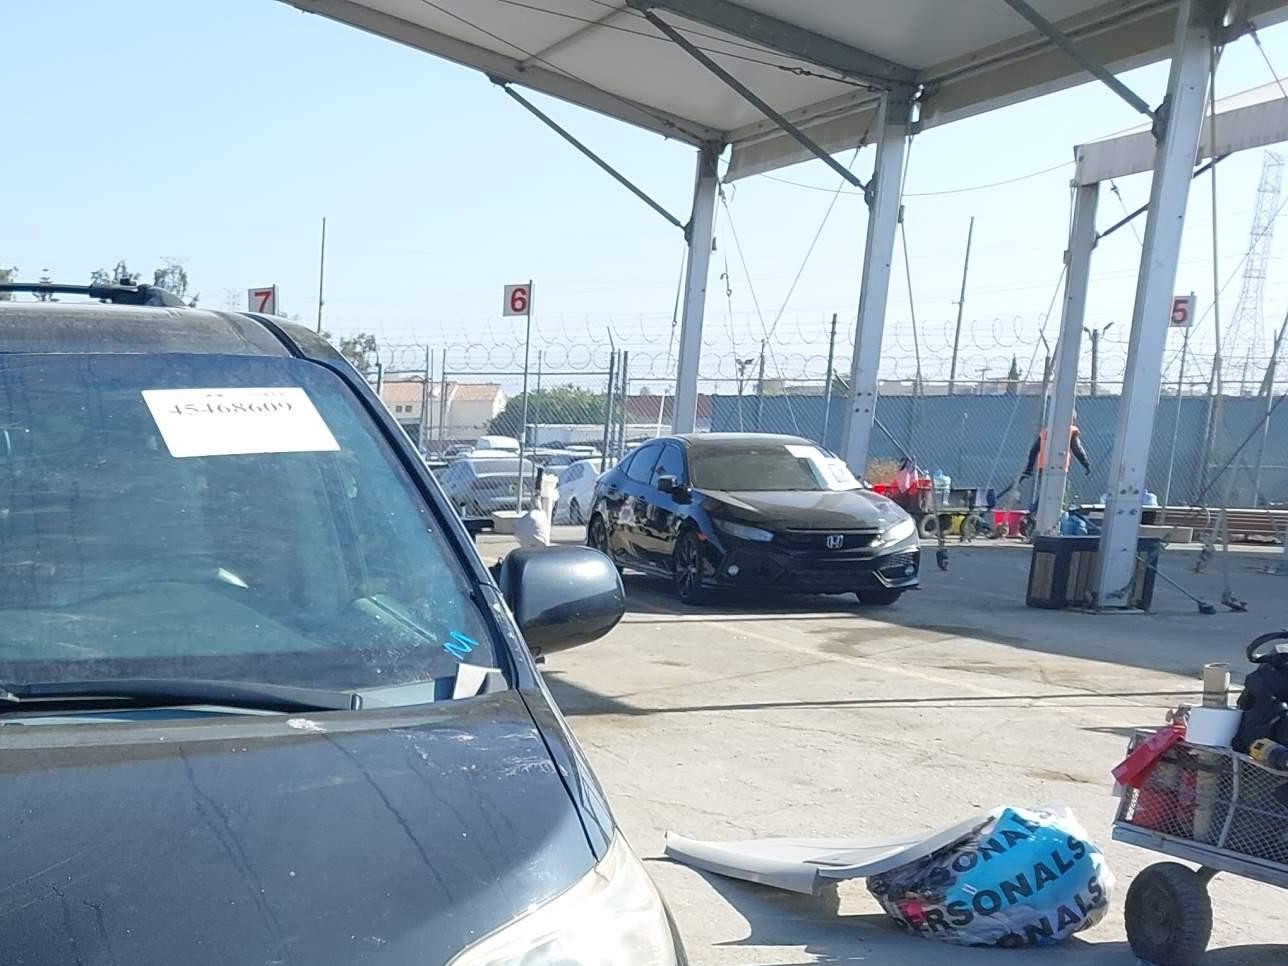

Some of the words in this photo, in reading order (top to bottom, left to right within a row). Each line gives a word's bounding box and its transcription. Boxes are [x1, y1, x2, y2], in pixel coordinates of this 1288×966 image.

[254, 291, 272, 313] 7
[511, 287, 527, 312] 6
[1171, 299, 1189, 325] 5
